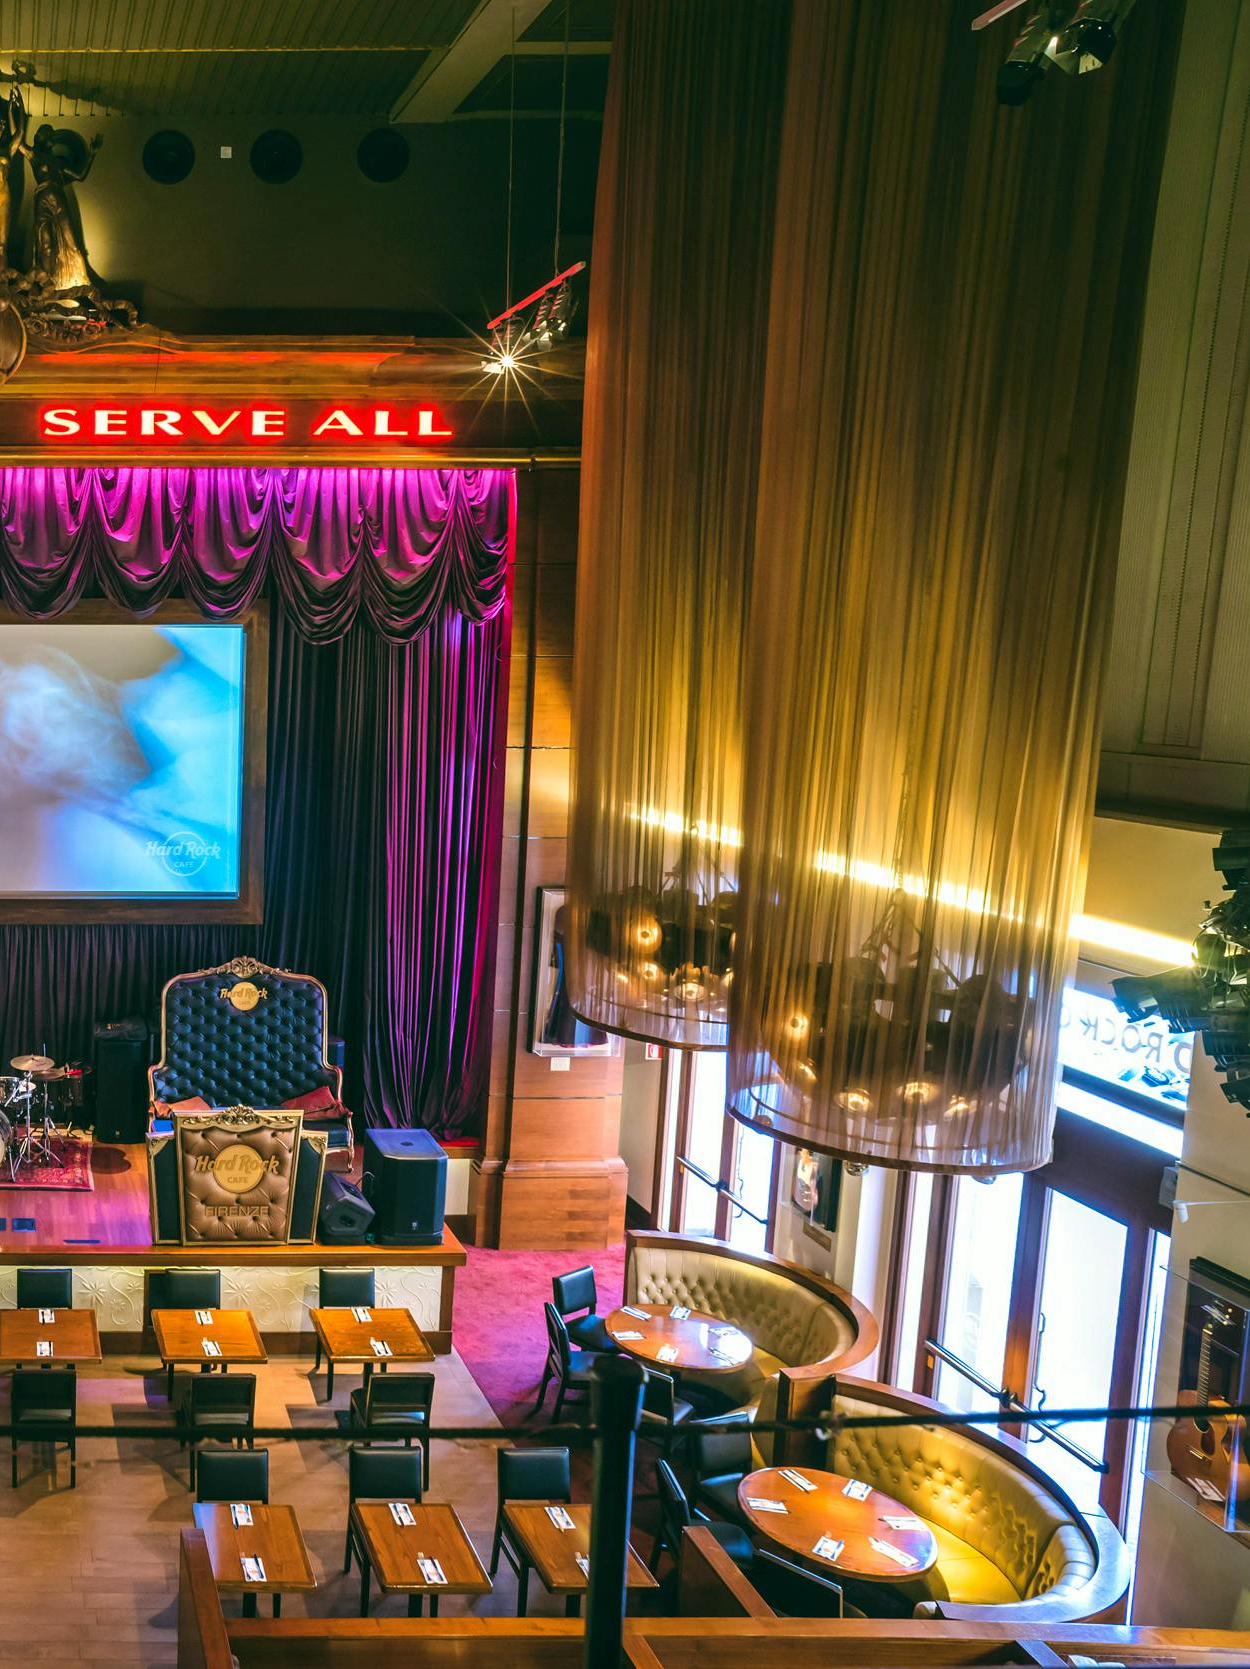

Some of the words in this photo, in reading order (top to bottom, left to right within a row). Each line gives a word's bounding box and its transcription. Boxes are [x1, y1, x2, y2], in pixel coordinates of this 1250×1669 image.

[43, 409, 285, 436] SERVE
[312, 409, 453, 436] ALL
[144, 840, 184, 857] Hard
[184, 841, 222, 860] Rock
[244, 987, 268, 1000] Rock
[194, 1154, 238, 1173] Hard
[237, 1154, 280, 1175] Rock
[226, 1176, 250, 1184] CAFE
[204, 1205, 270, 1217] FIRENZE
